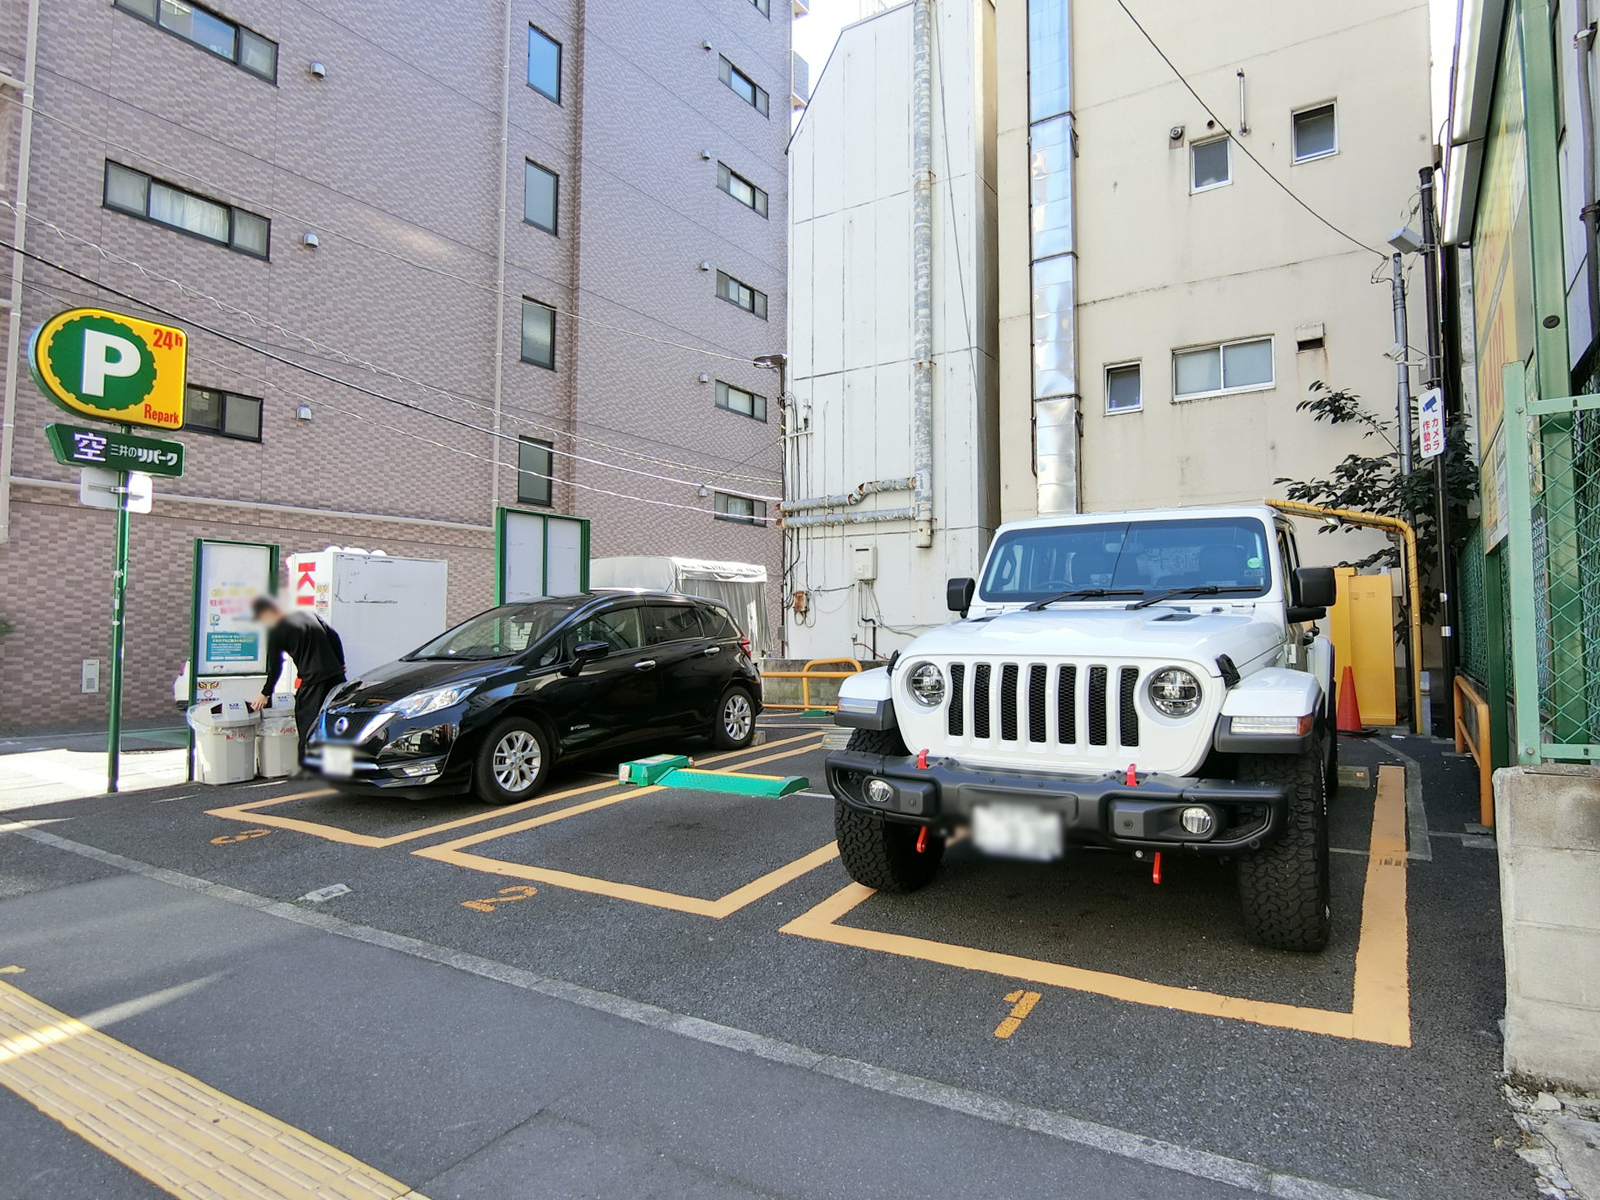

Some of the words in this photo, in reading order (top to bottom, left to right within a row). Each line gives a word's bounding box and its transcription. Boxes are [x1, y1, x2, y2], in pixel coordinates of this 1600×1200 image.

[153, 328, 183, 350] 24h
[82, 328, 141, 397] P
[144, 403, 179, 424] Repark
[73, 432, 107, 462] 空
[1423, 420, 1431, 453] 作動中
[1432, 417, 1440, 451] カメラ
[110, 444, 178, 465] 三井のリパーク
[460, 885, 538, 913] 2
[993, 989, 1042, 1039] 1
